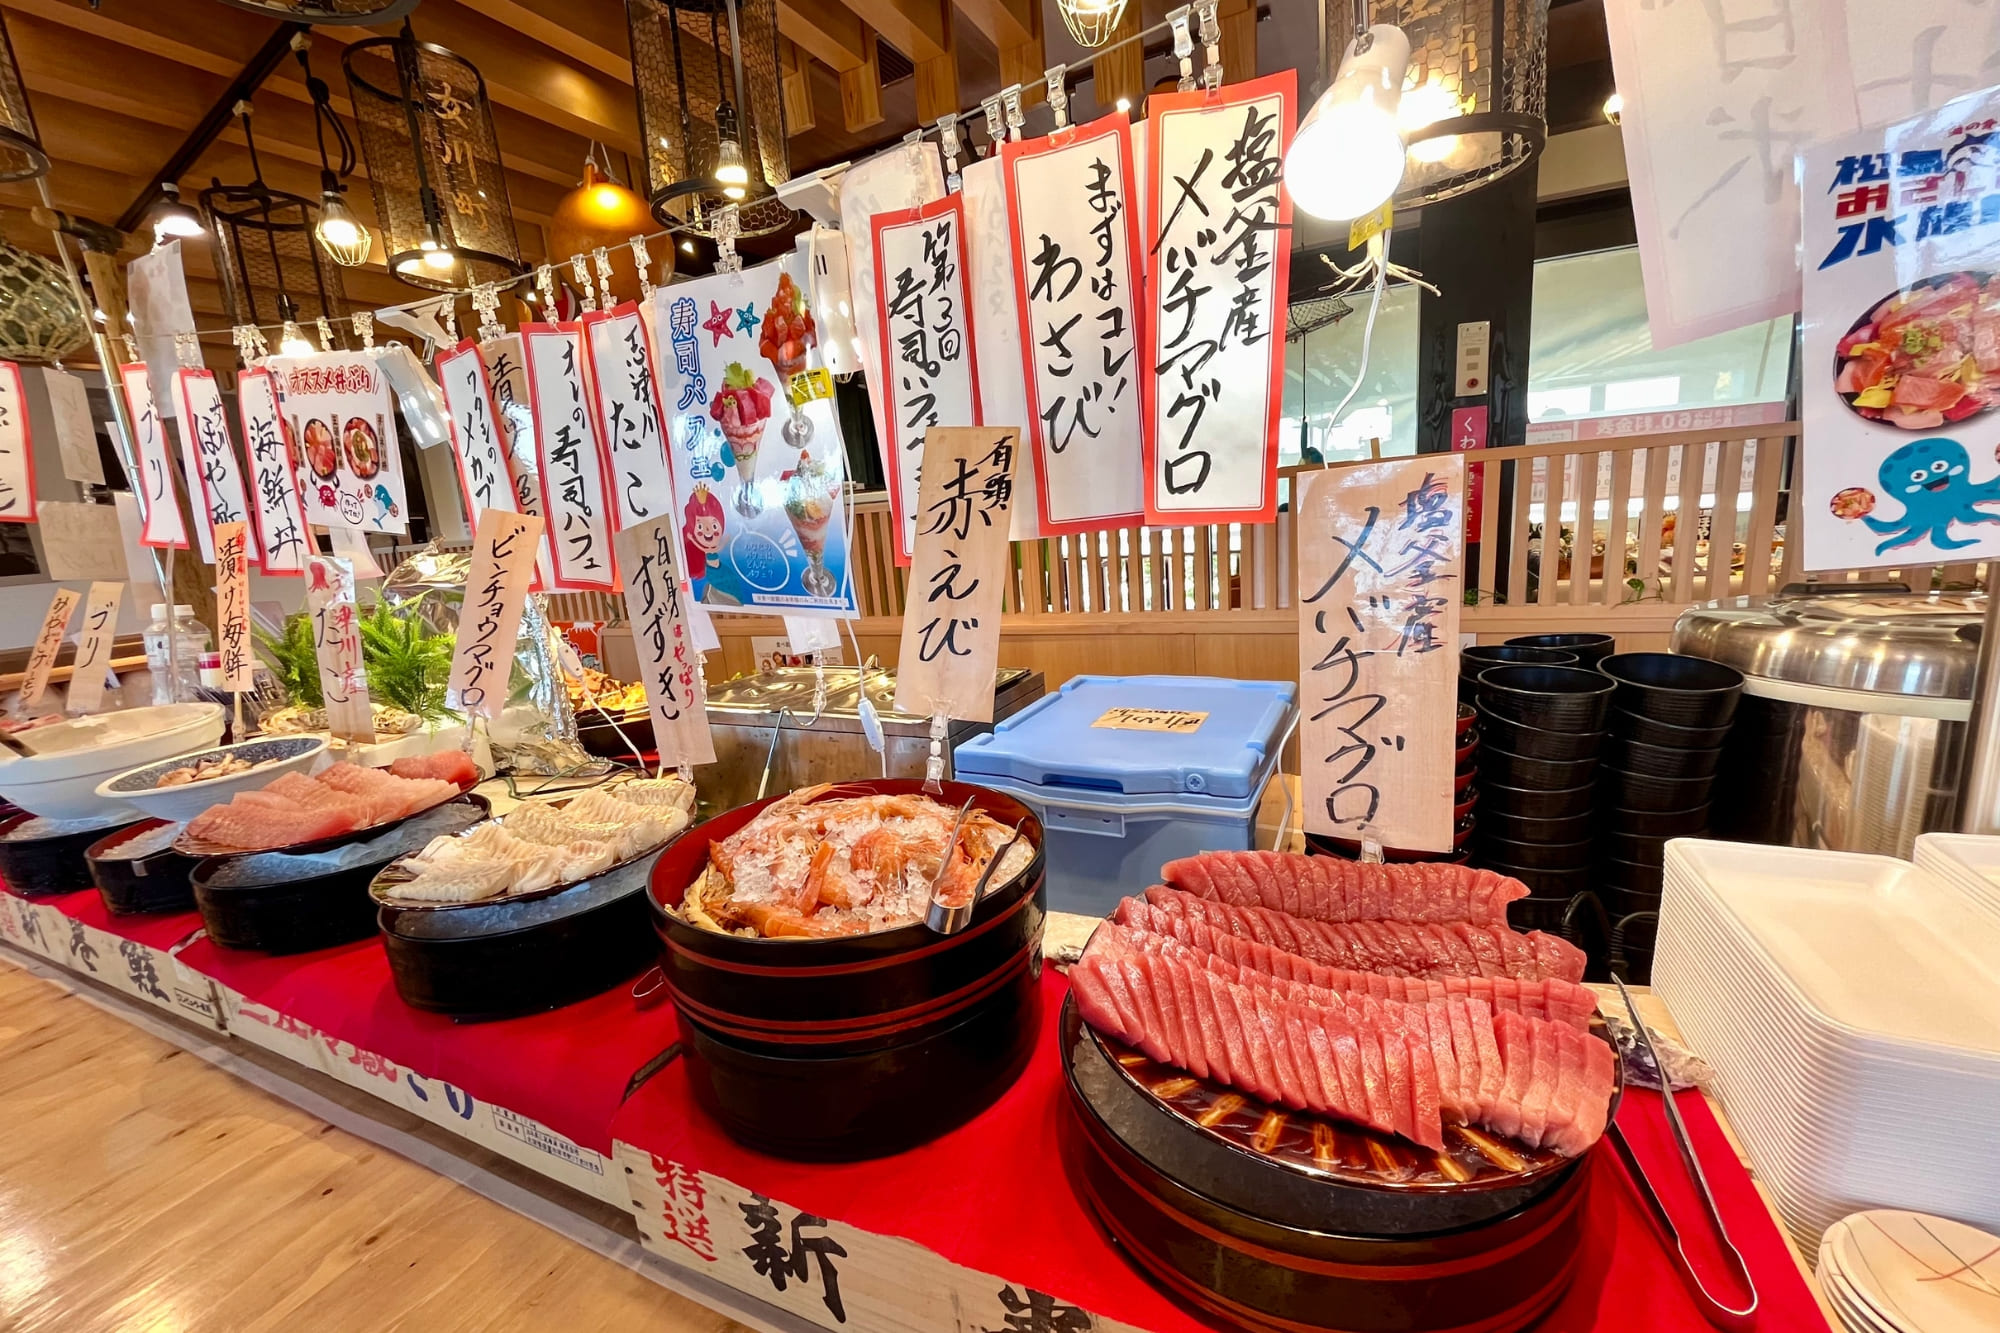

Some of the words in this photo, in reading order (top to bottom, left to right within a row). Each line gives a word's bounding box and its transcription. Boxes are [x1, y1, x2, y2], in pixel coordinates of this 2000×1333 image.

[1085, 157, 1135, 413] まずはコレ!
[1211, 106, 1292, 352] 塩釜産
[288, 364, 373, 395] オススメ丼ぶり
[668, 297, 714, 482] 寿司パフェ
[1030, 234, 1101, 454] わさび
[1151, 148, 1221, 495] メバチマグロ
[248, 417, 304, 562] 海鮮丼
[606, 401, 649, 518] たこ
[975, 435, 1014, 511] 有頭
[80, 601, 113, 668] ブリ
[218, 537, 249, 682] 漬け海鮮
[461, 525, 526, 707] ビンチョウマグロ
[632, 555, 680, 720] すずき
[918, 458, 992, 662] 赤えび
[314, 607, 350, 703] たこ
[1302, 507, 1405, 830] メバチマグロ
